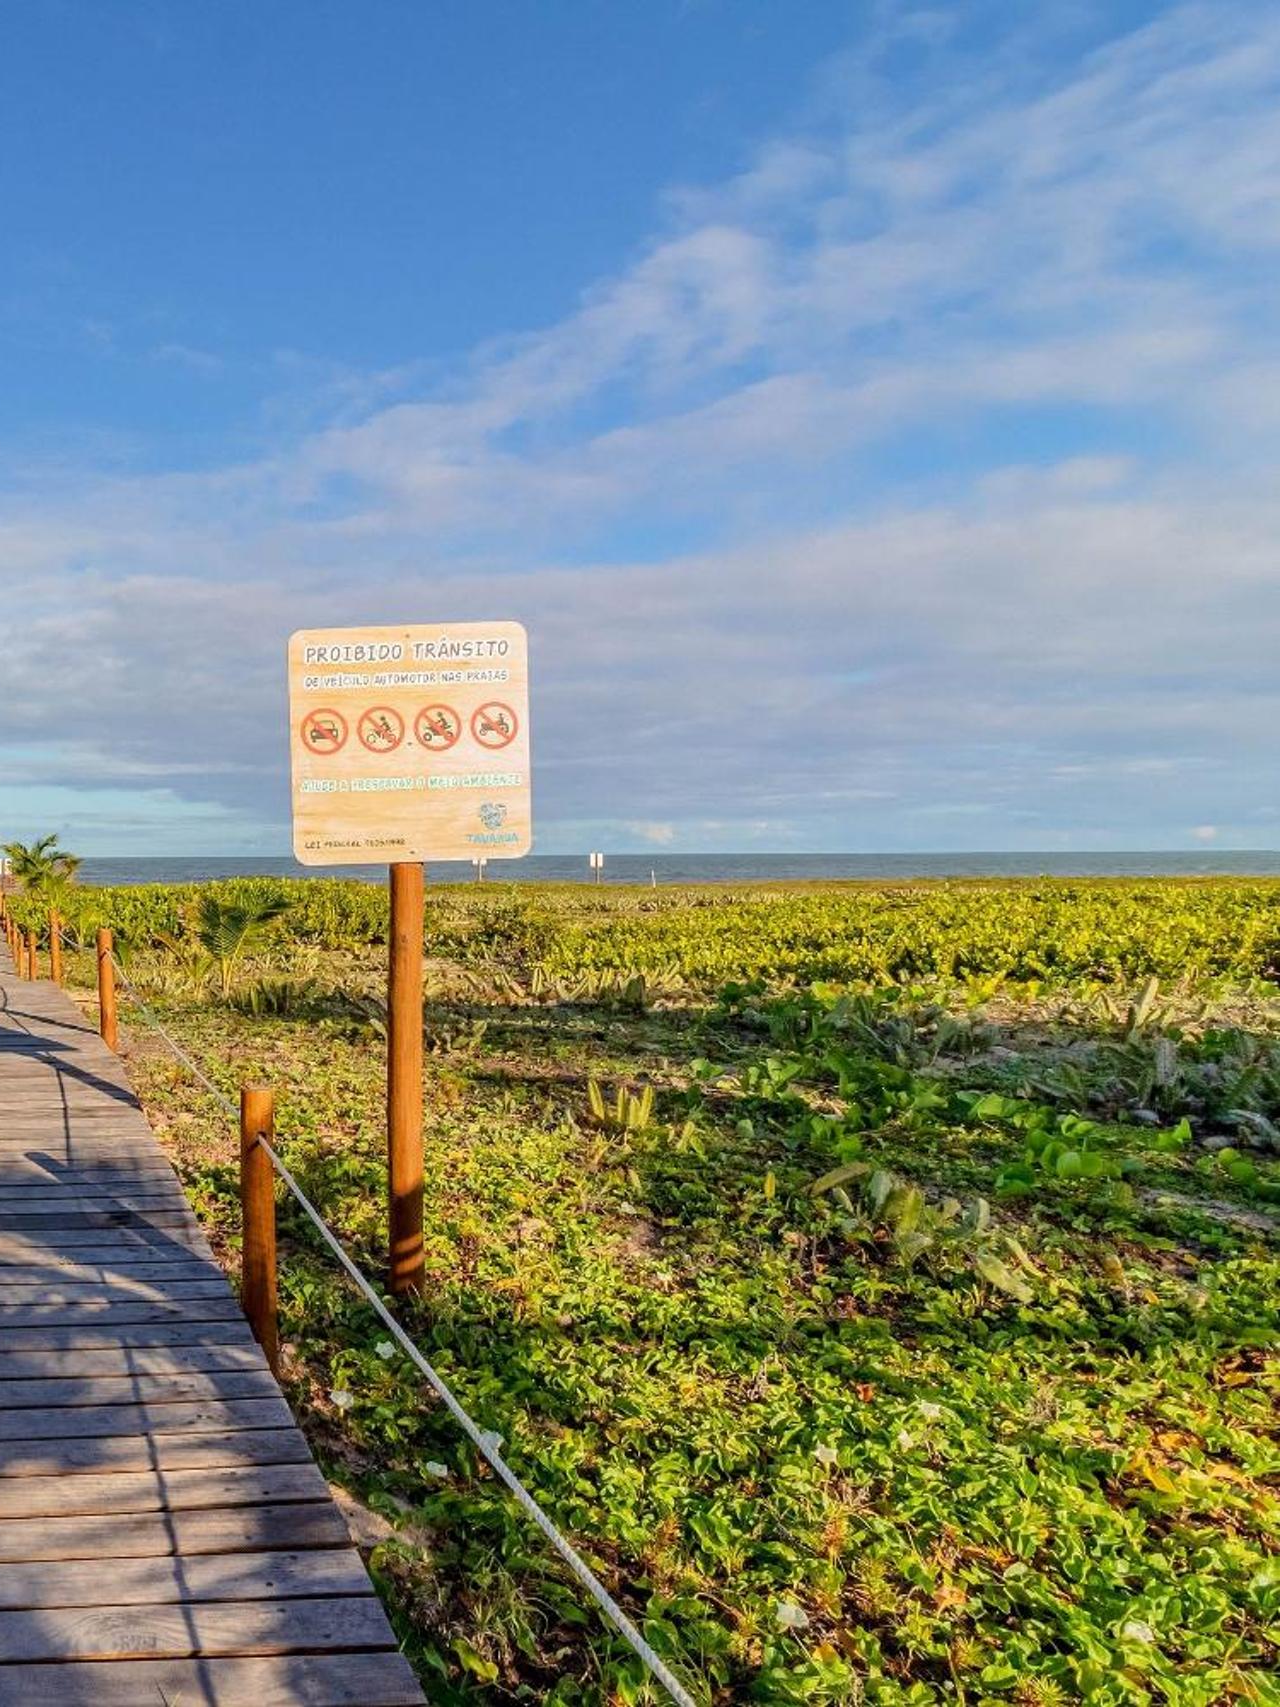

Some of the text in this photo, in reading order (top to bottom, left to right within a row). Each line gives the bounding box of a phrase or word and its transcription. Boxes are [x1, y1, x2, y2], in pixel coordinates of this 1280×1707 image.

[305, 638, 509, 663] PROIBIDO TRÂNSITO
[305, 670, 508, 688] DE VEÍCULO AUTOMOTOR NAS PRAIAS
[304, 840, 321, 849] LEI
